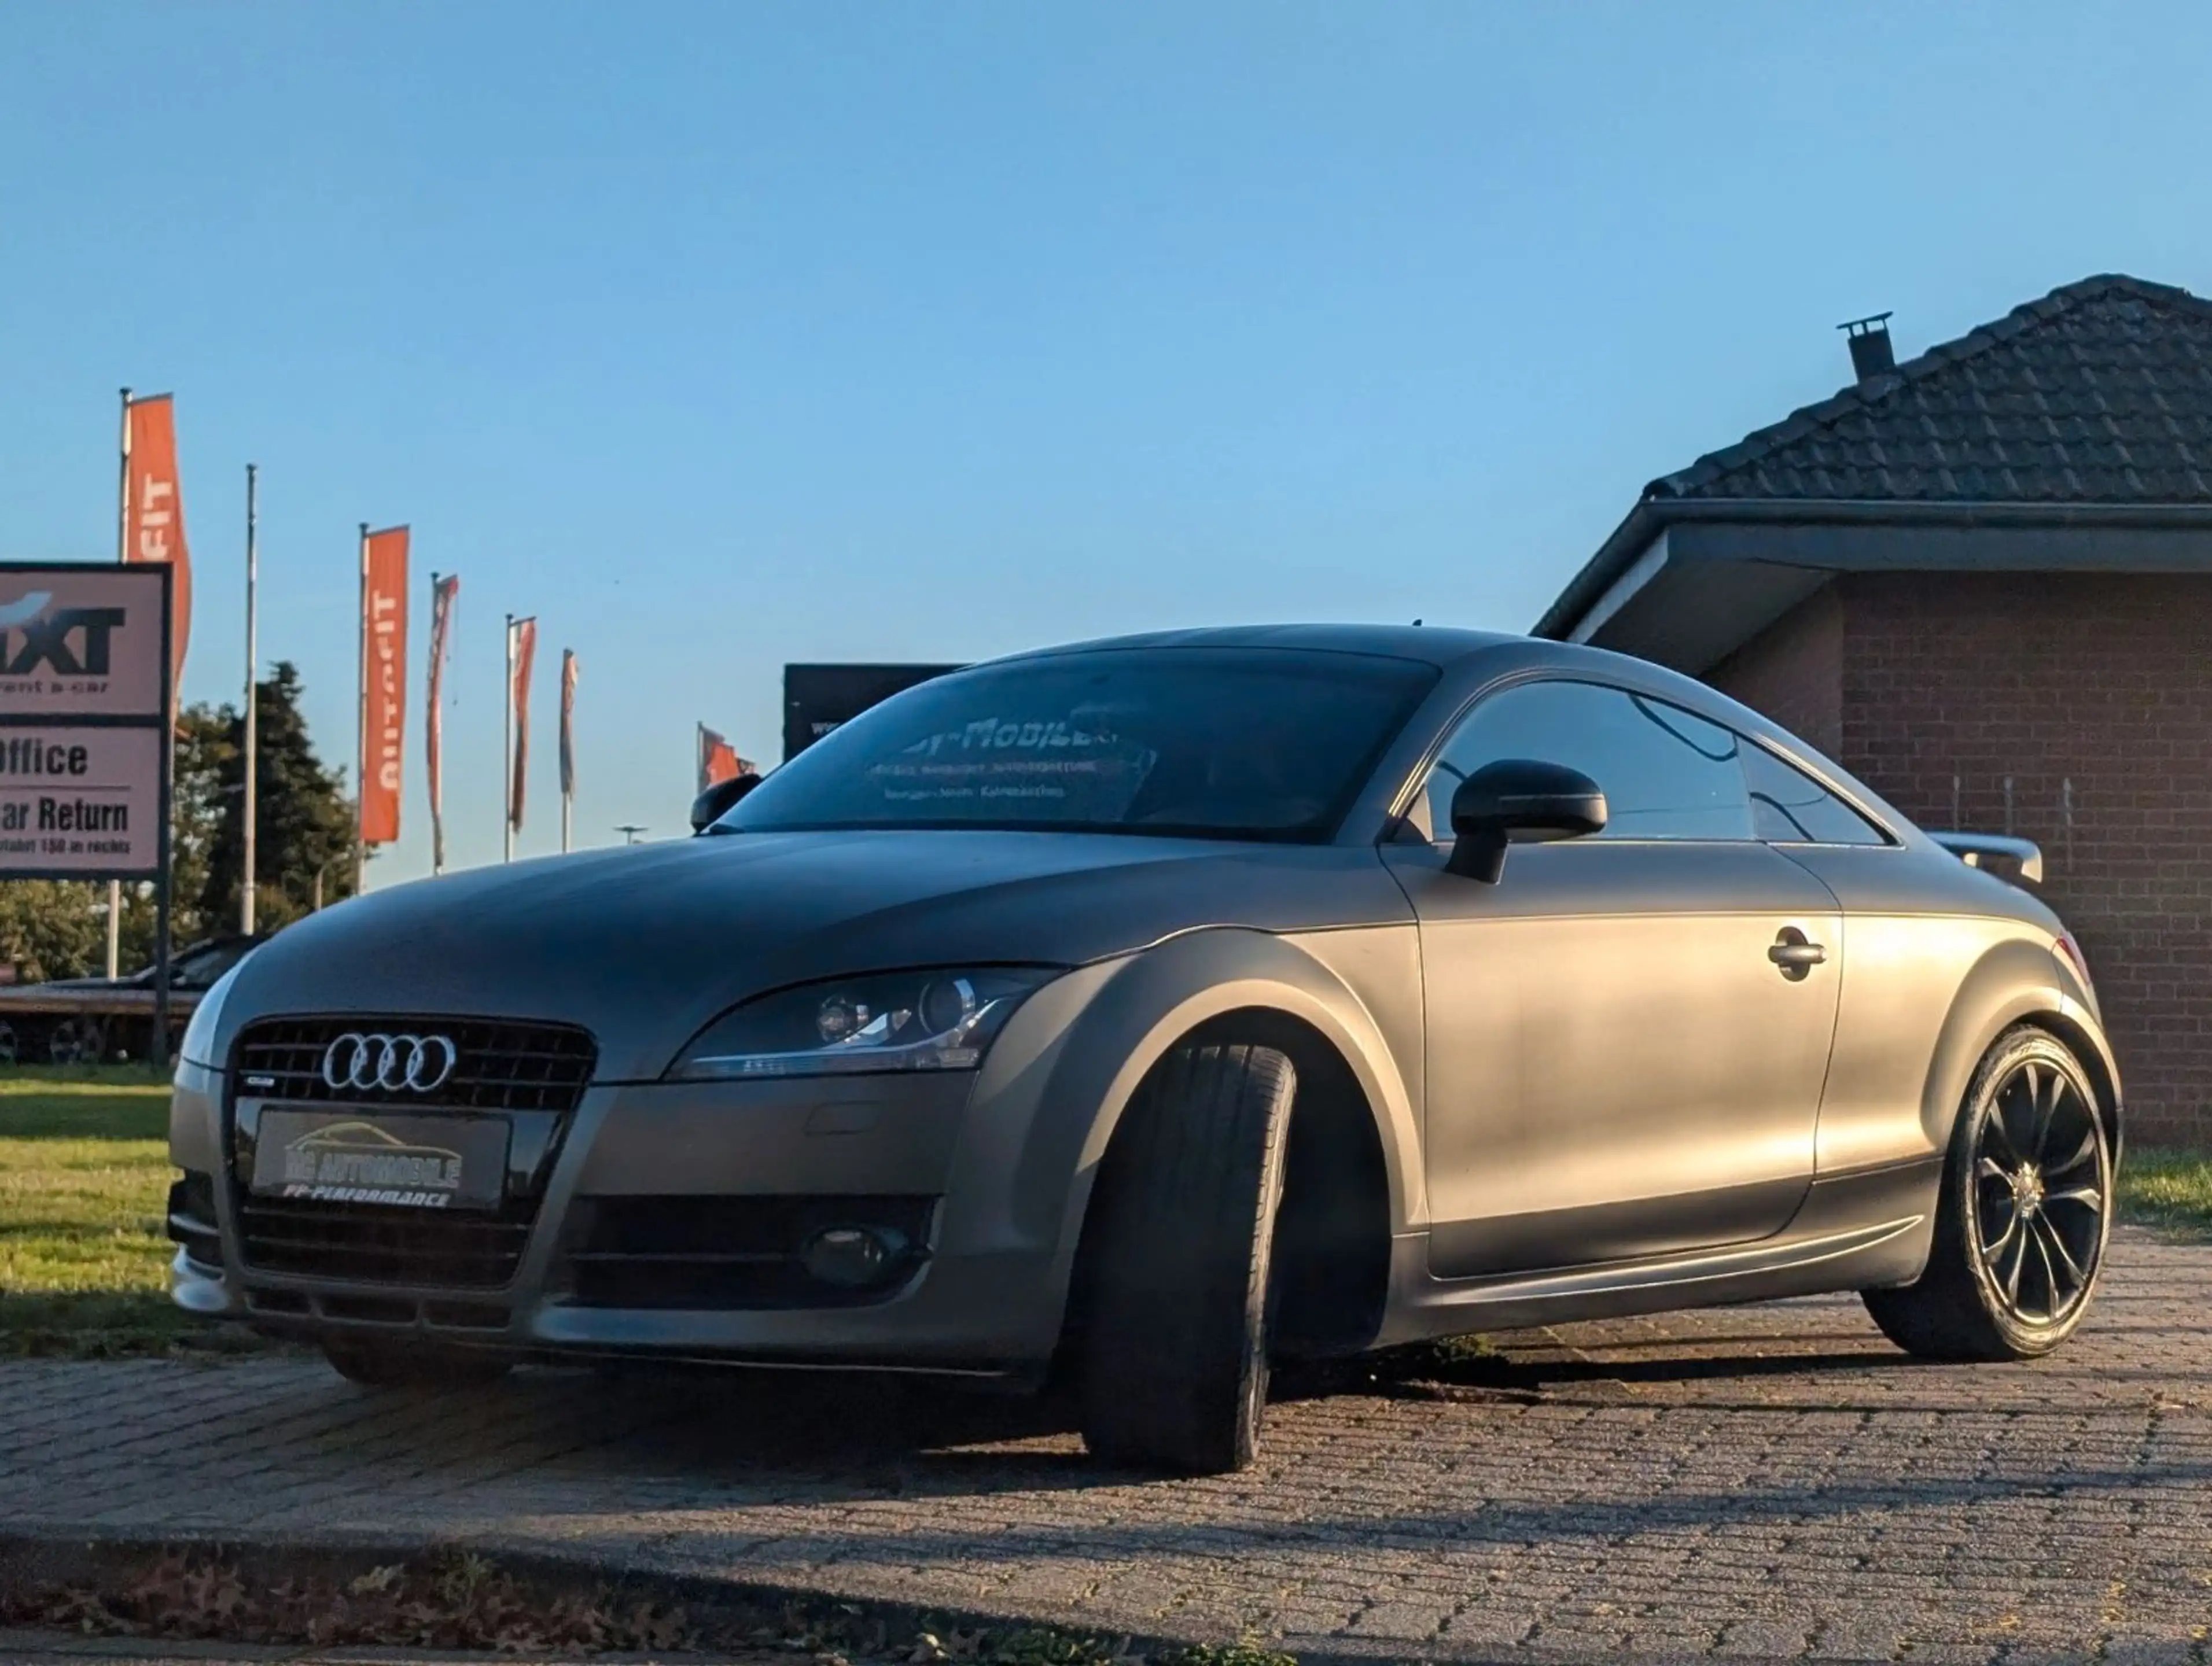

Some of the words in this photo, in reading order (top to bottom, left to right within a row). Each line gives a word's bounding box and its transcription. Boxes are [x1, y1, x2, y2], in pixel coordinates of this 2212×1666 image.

[139, 473, 173, 559] FIT
[0, 736, 89, 776] ffice
[0, 802, 31, 831] ar
[38, 795, 129, 832] Return
